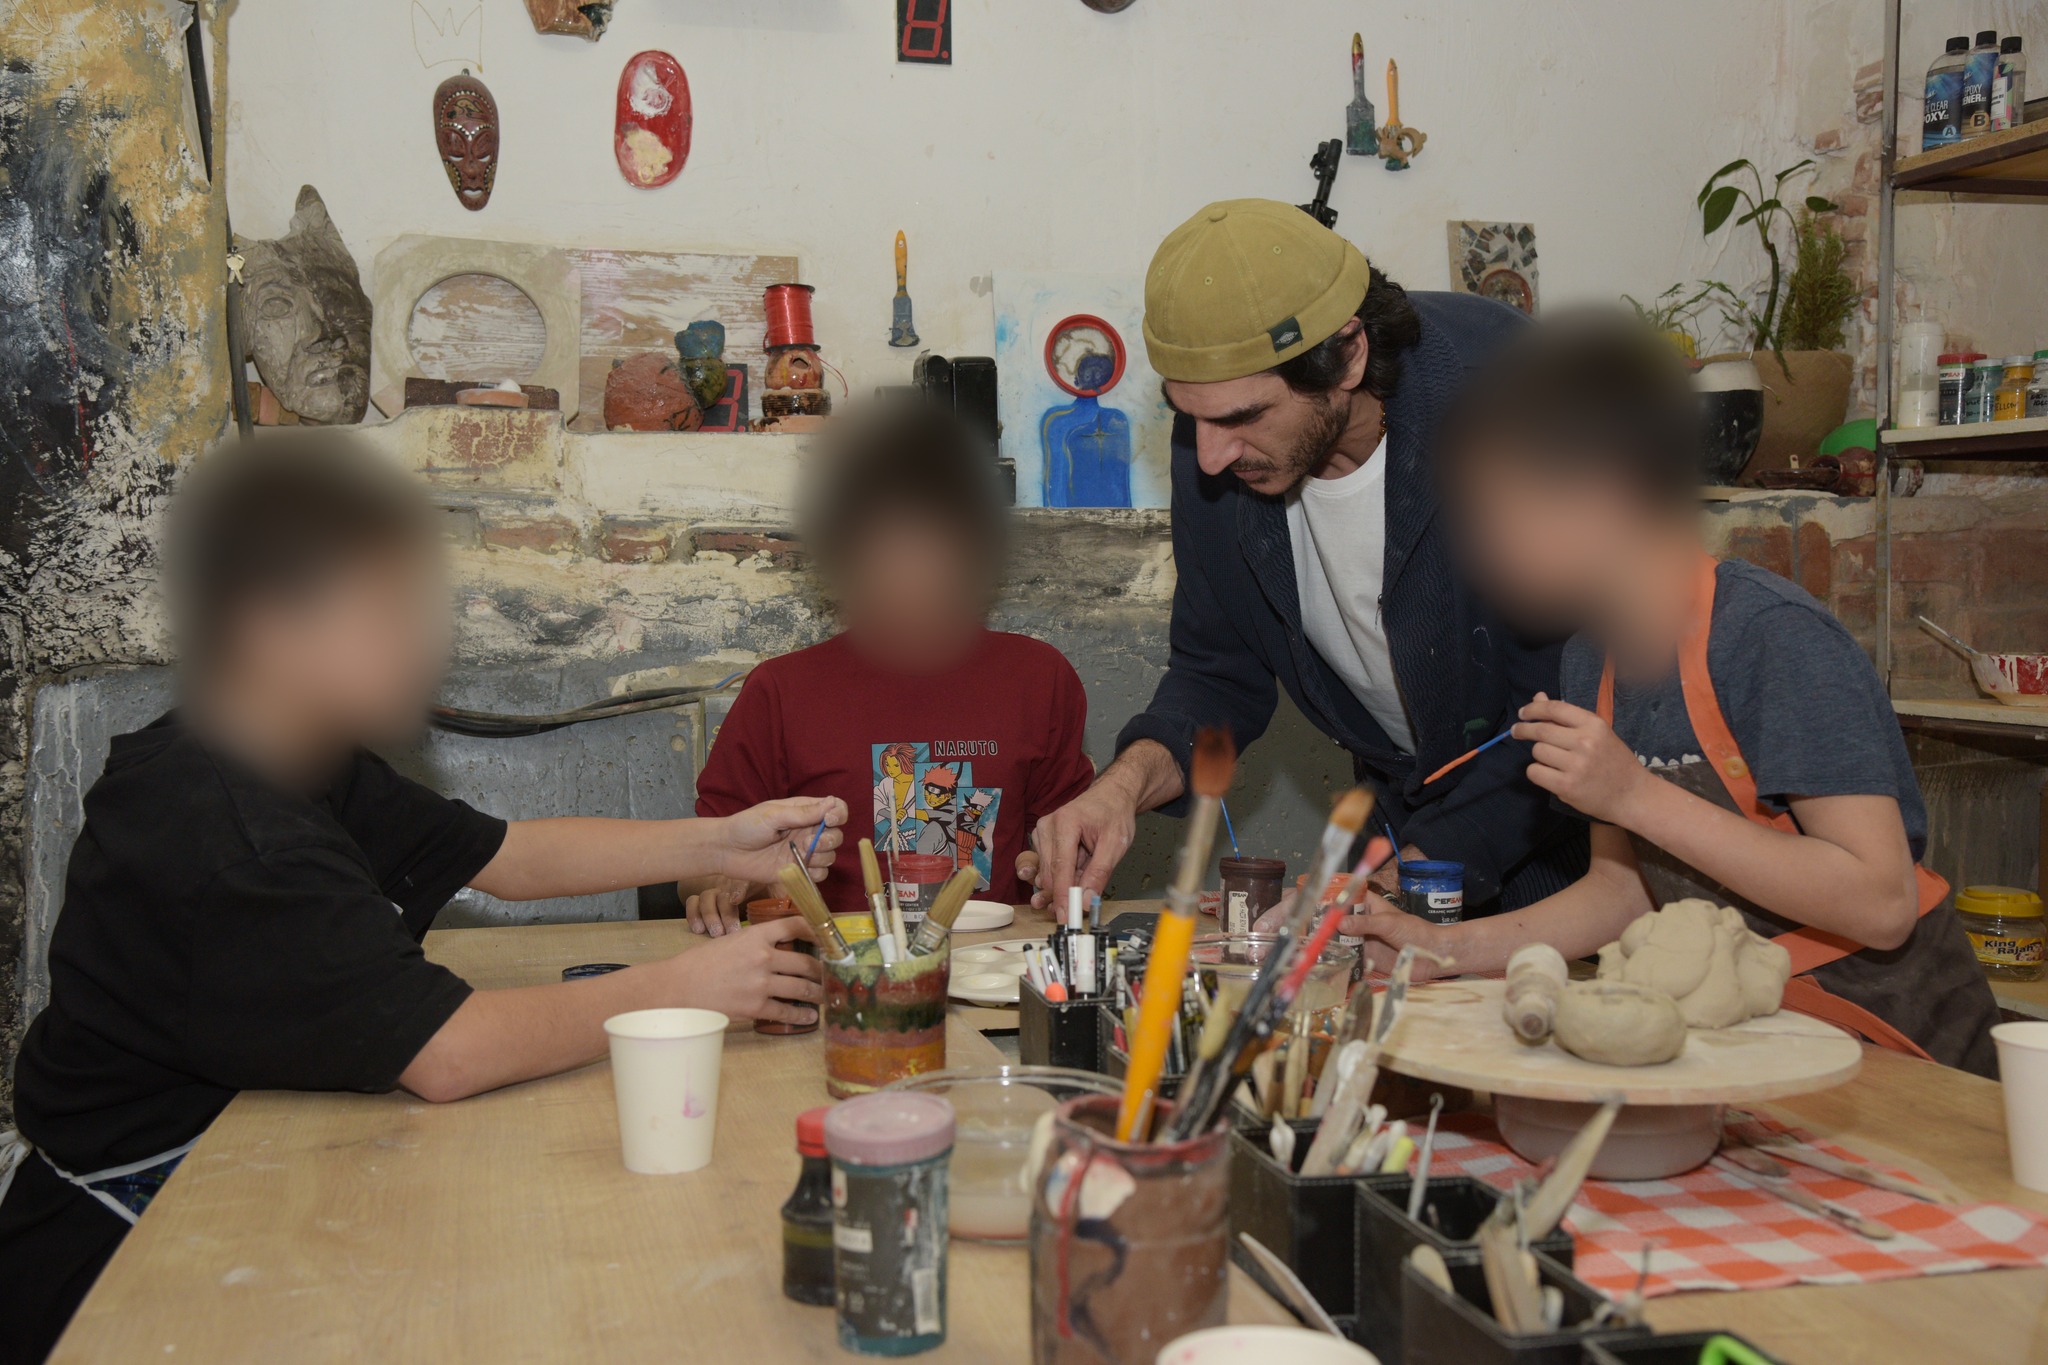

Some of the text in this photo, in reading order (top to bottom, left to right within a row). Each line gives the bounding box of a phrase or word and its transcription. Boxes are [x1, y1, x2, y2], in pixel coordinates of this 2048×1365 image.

[1930, 99, 1949, 112] CLEAR
[1924, 110, 1947, 124] OXY
[1974, 114, 1986, 127] B
[1945, 127, 1954, 136] A
[935, 740, 999, 757] NARUTO
[897, 890, 916, 898] SAN
[1985, 940, 2016, 948] King
[1997, 945, 2034, 955] Rajah
